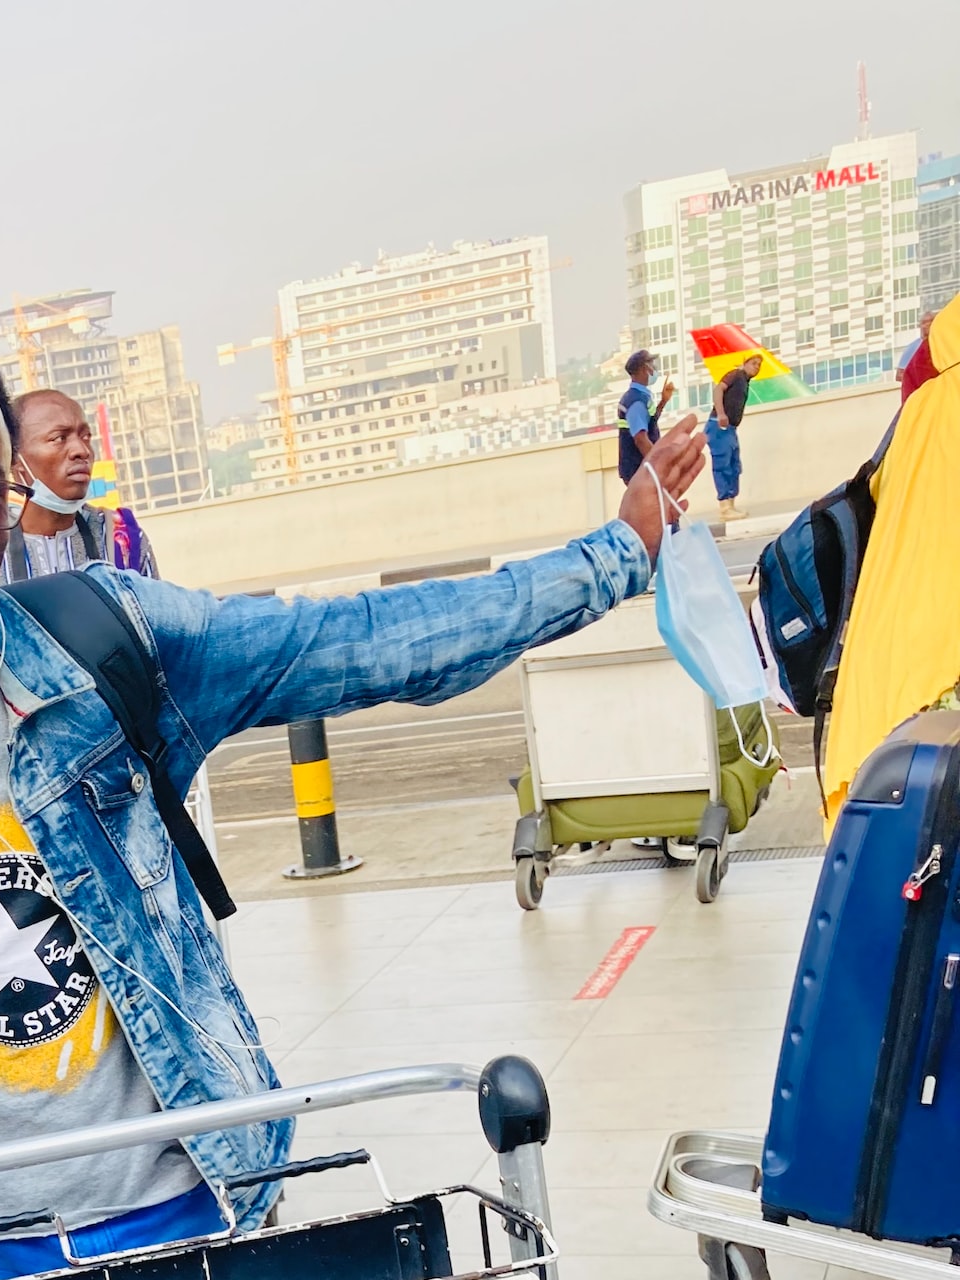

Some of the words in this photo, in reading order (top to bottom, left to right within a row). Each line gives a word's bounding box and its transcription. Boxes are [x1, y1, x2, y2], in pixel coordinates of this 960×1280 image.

[711, 175, 809, 211] MARINA
[815, 162, 879, 191] MALL
[22, 972, 90, 1037] STAR
